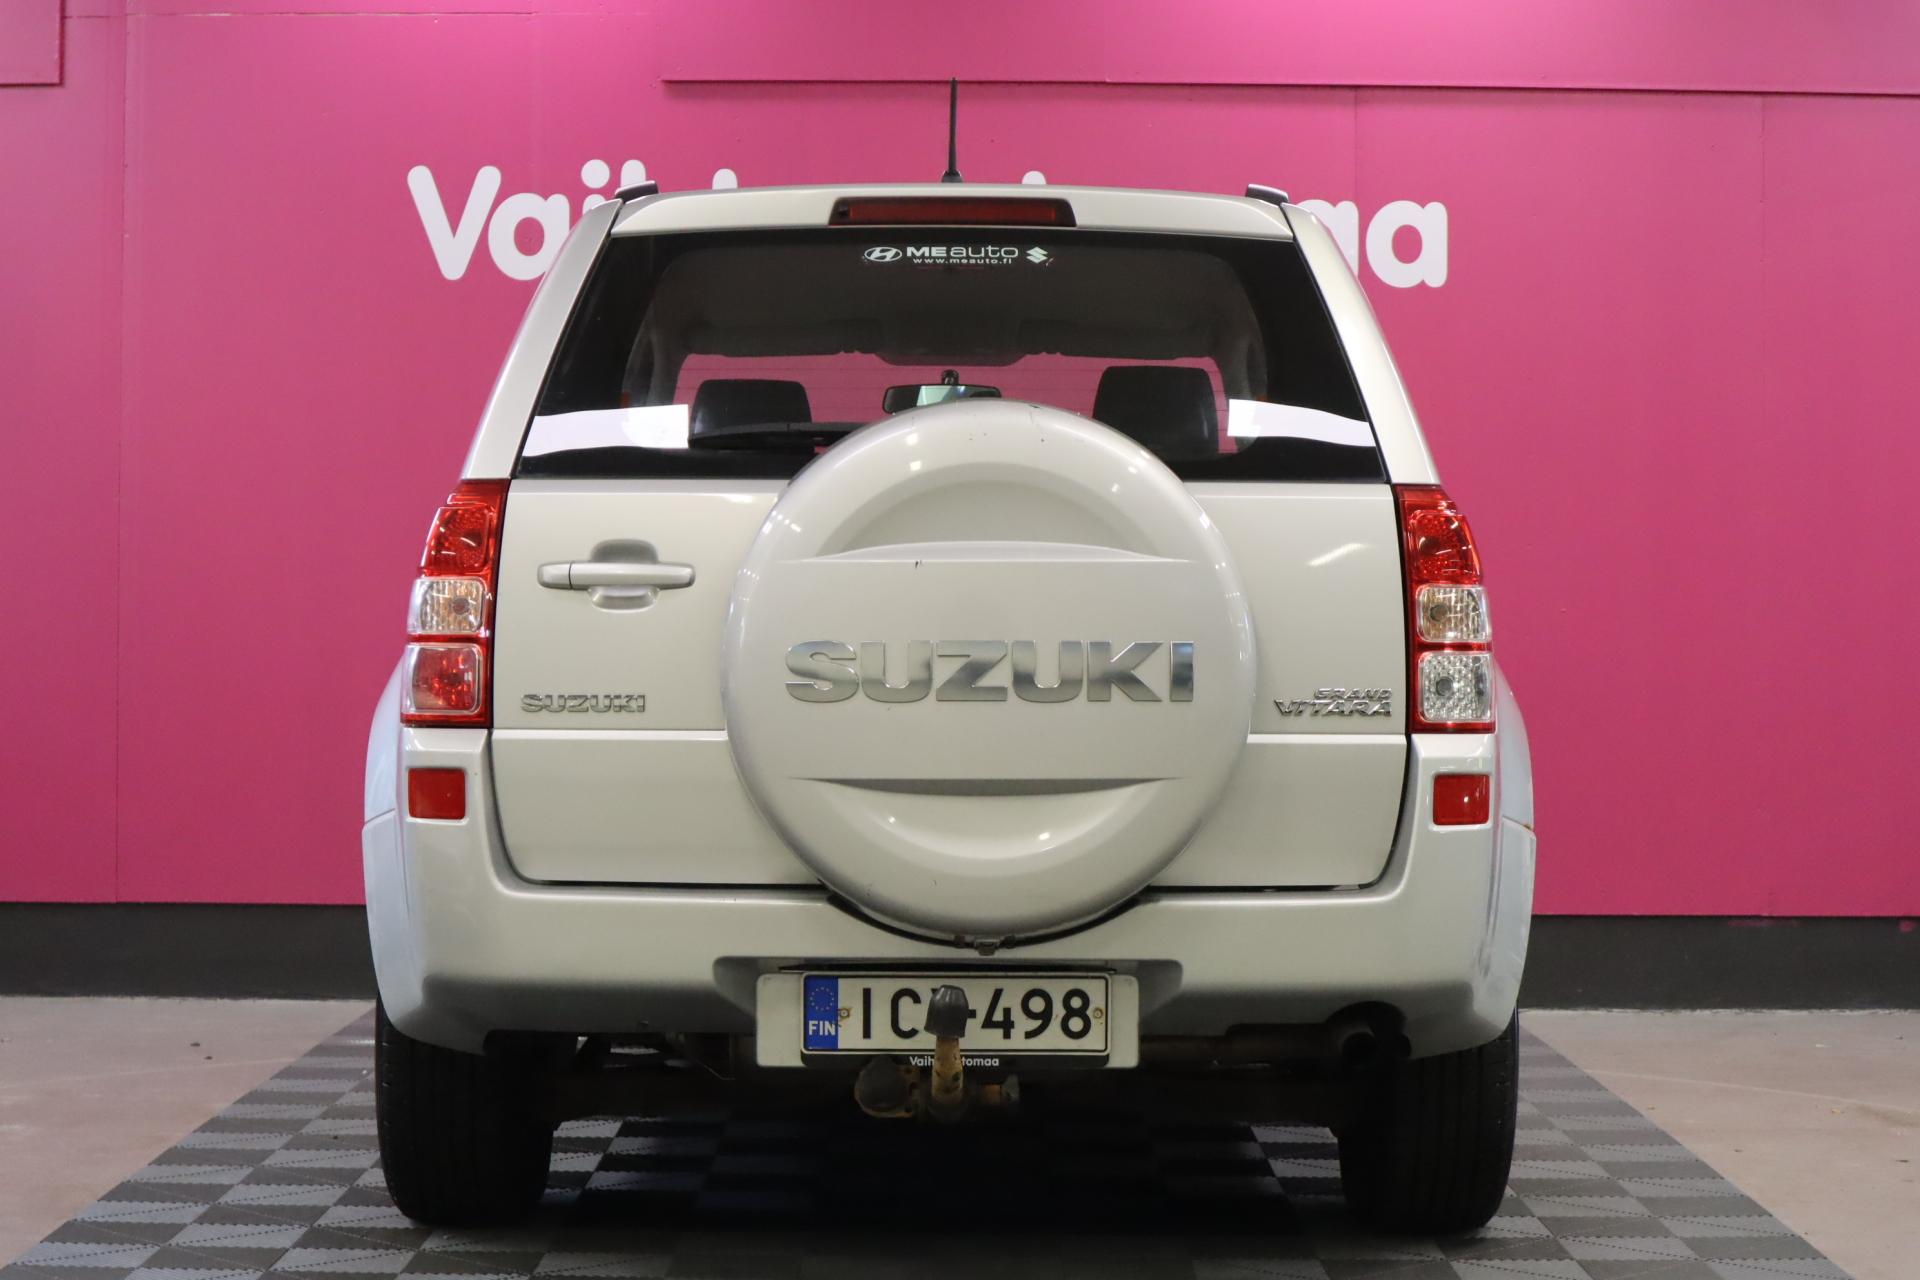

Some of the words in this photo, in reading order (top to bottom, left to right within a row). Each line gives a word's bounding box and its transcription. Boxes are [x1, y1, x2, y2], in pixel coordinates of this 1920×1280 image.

[912, 257, 1013, 265] www.meauto.fi
[784, 640, 1194, 703] SUZUKI
[1313, 687, 1393, 700] GRAND
[520, 694, 646, 713] SUZUKI
[1273, 699, 1393, 716] VITARA
[862, 987, 1092, 1040] IC-498
[808, 1020, 836, 1036] FIN
[909, 1055, 1000, 1067] Vaihtomaa
